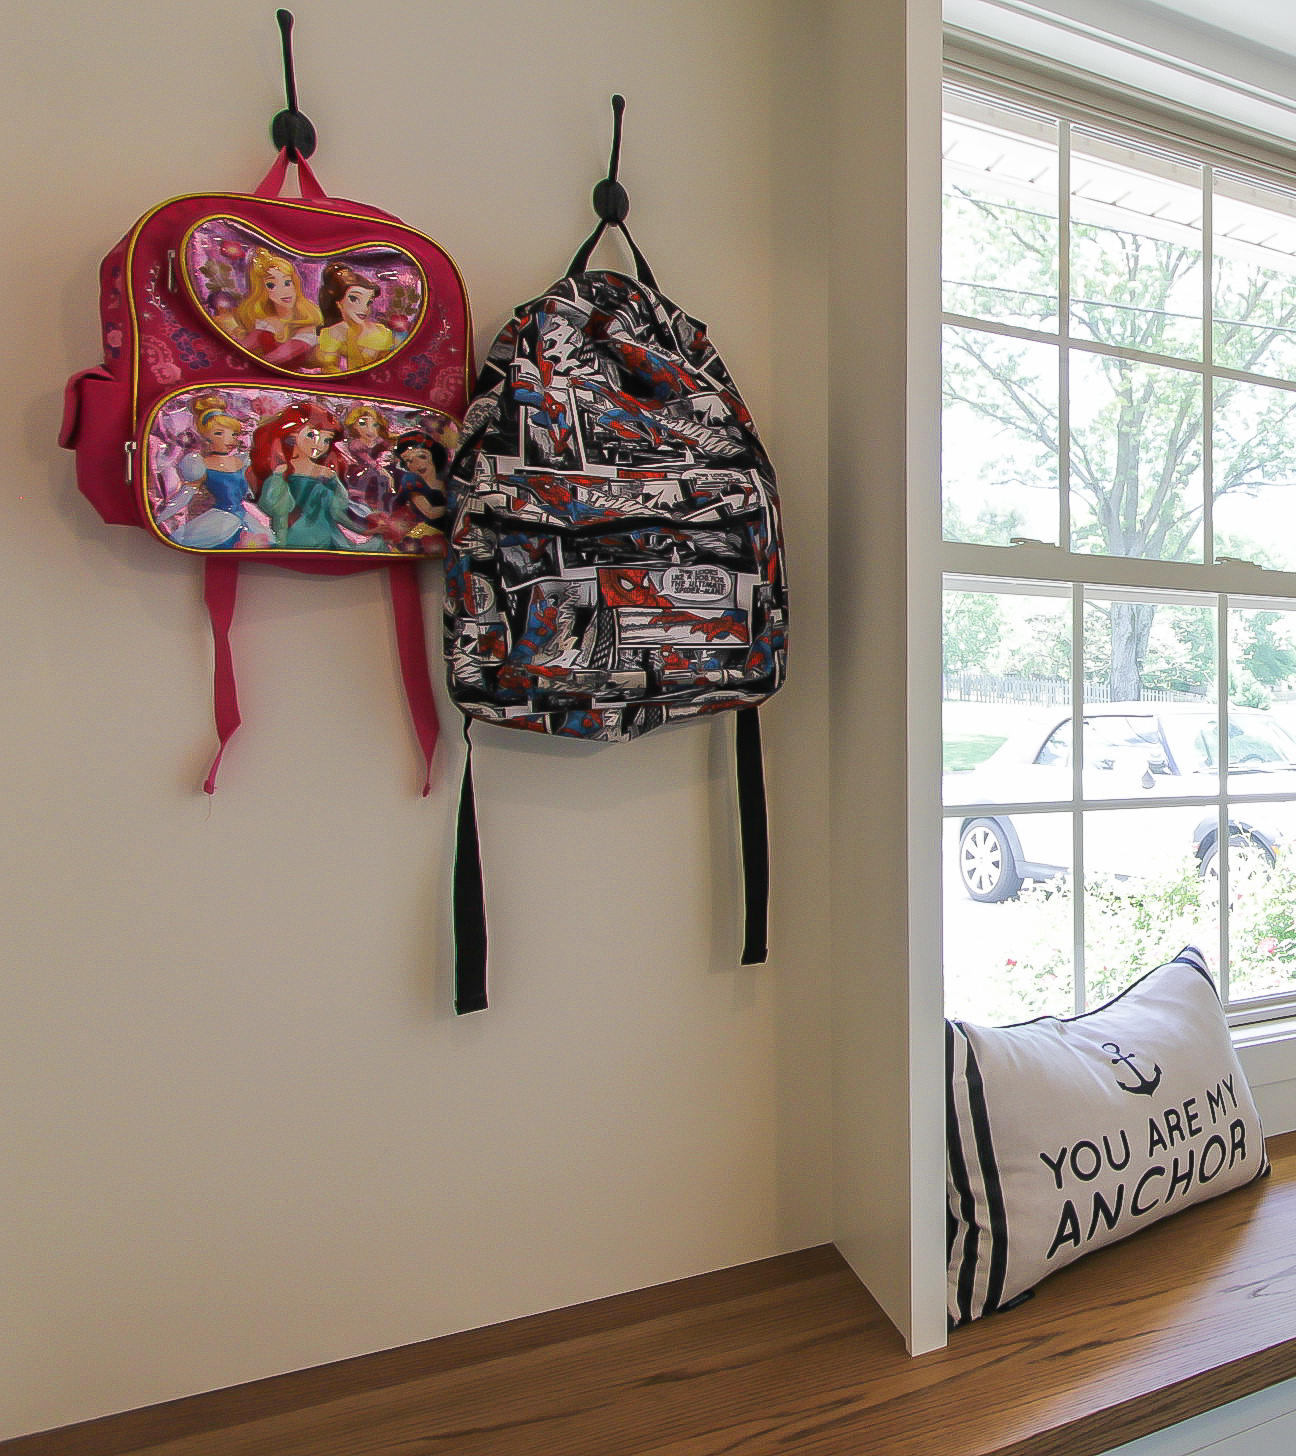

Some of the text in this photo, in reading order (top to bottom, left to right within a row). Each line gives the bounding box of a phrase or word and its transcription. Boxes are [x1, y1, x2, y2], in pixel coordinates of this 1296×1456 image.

[1039, 1073, 1238, 1190] YOU ARE MY
[1046, 1118, 1246, 1259] ANCHOR
